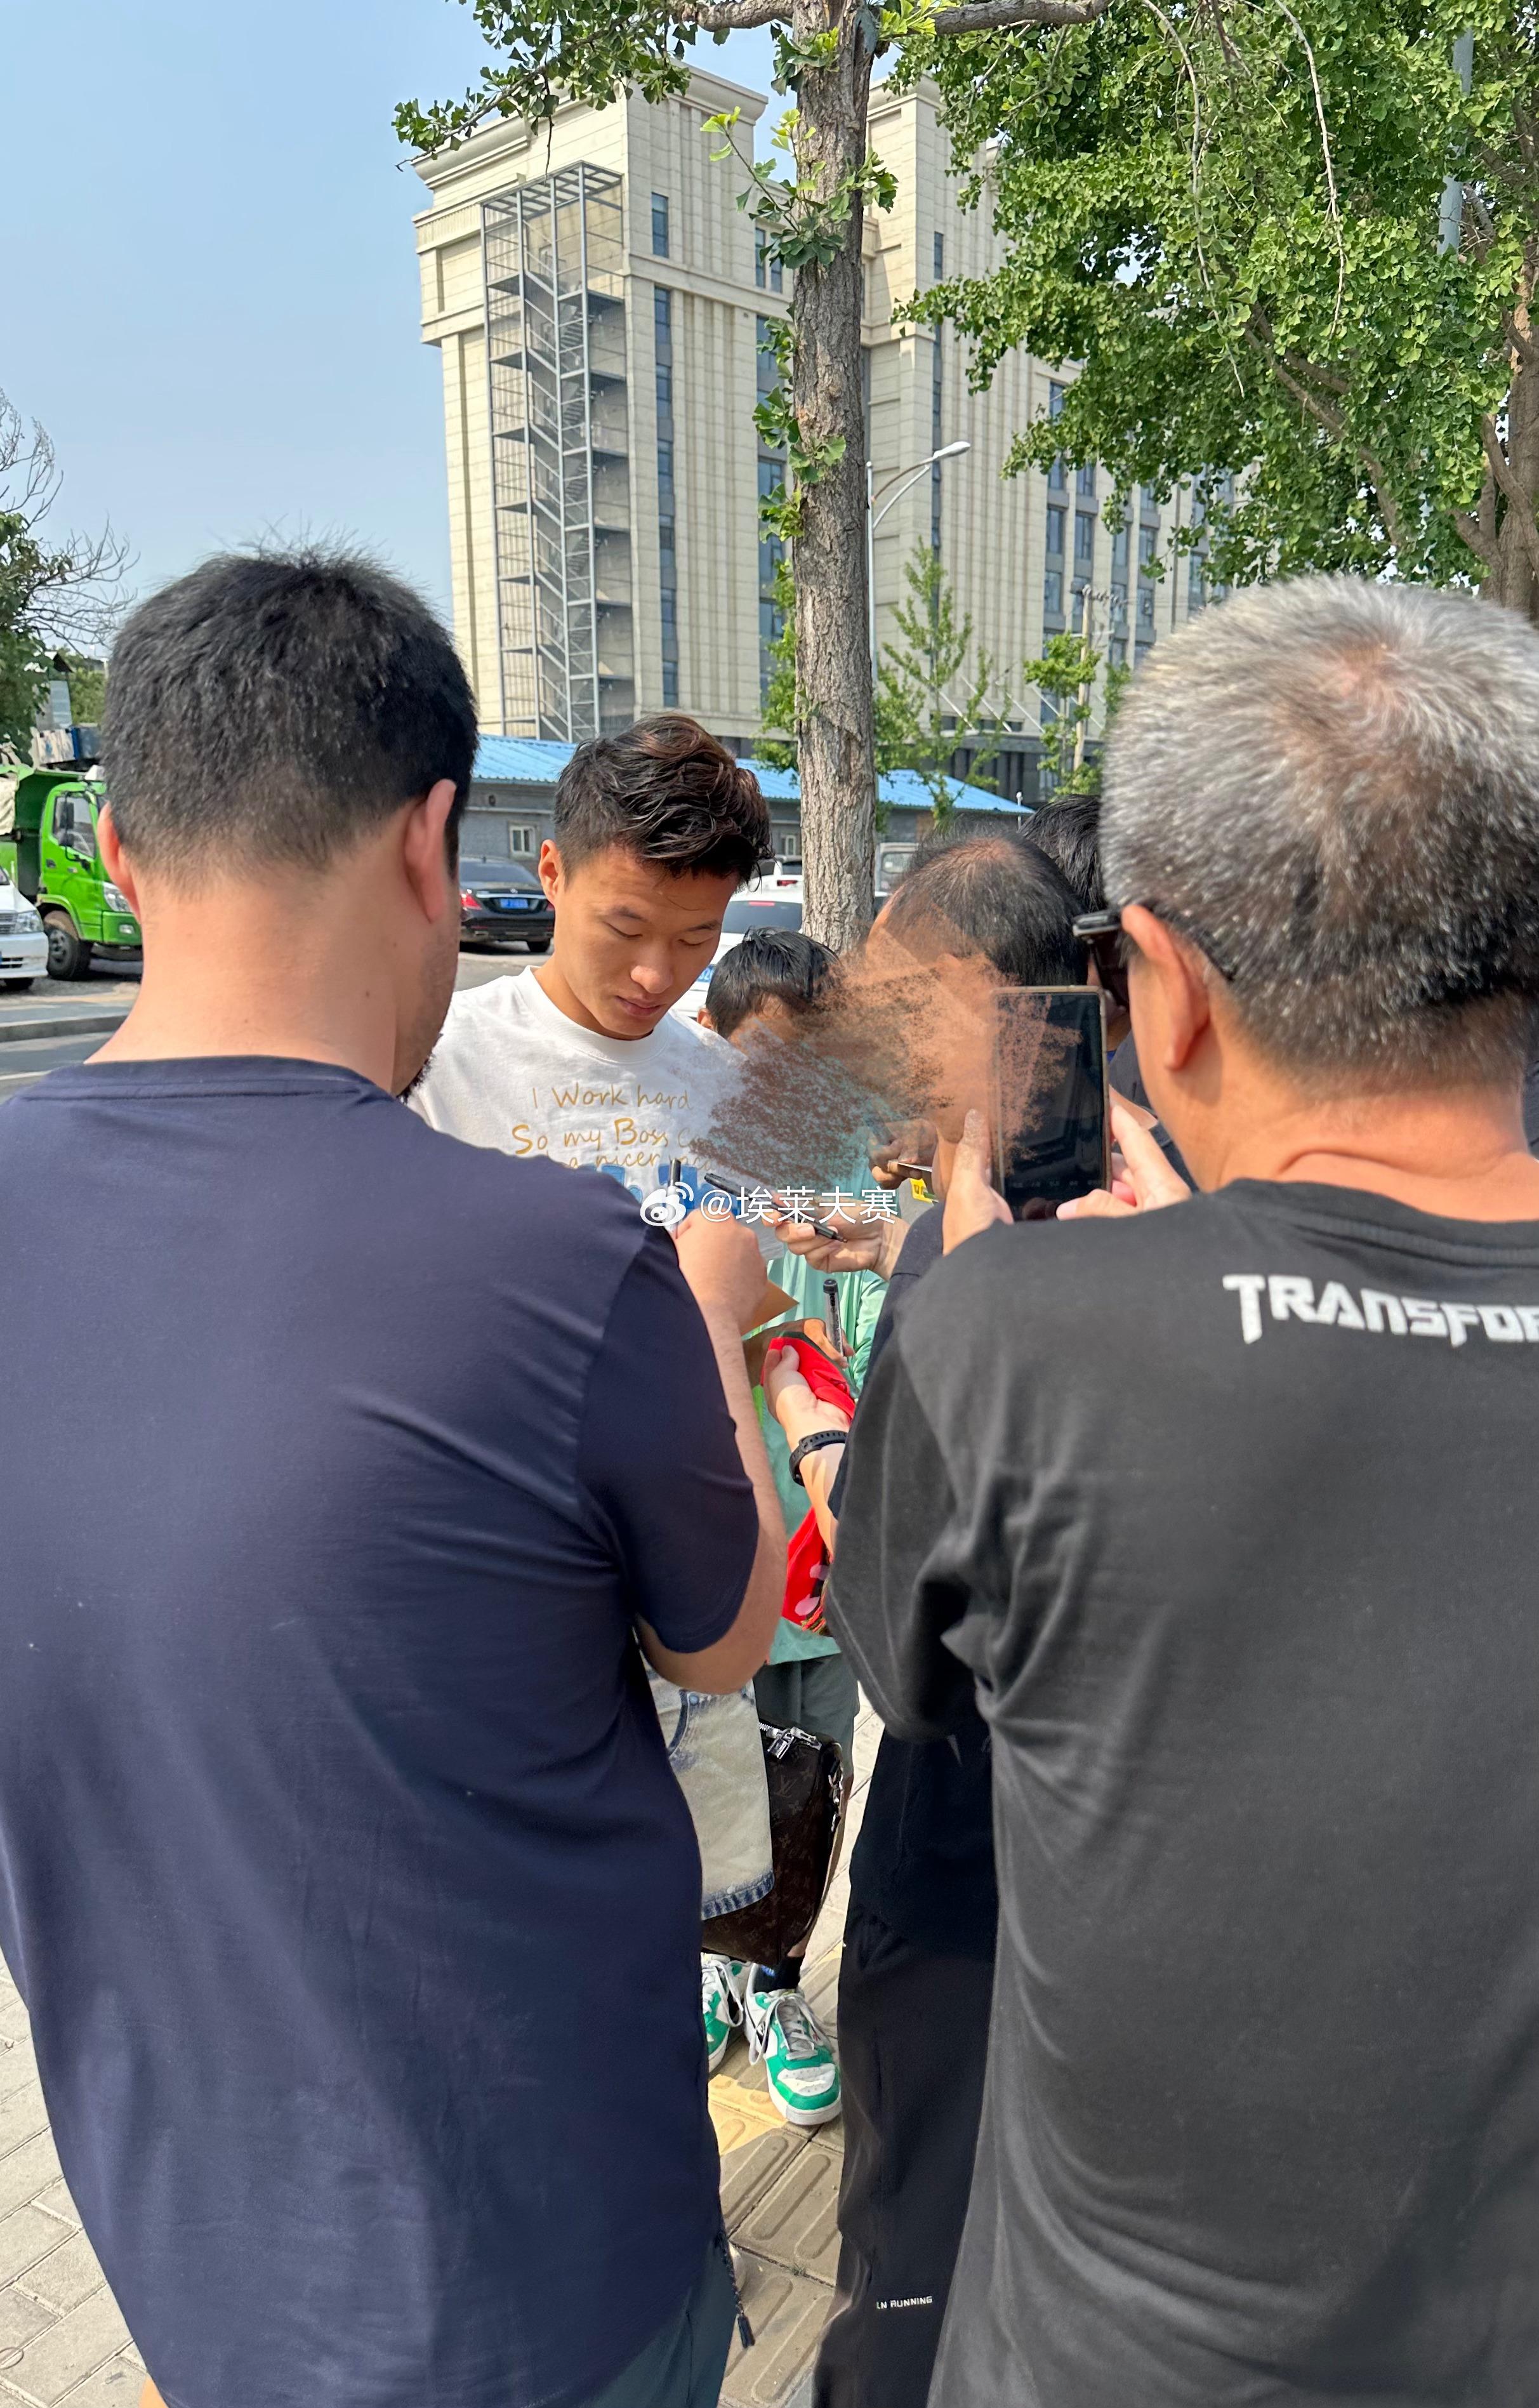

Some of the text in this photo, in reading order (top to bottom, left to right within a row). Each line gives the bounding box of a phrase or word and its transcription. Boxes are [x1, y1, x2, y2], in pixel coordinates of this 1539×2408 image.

[532, 1081, 694, 1109] I Work hard
[512, 1123, 548, 1155] So
[564, 1129, 601, 1151] my
[614, 1116, 669, 1148] Boss
[595, 1146, 661, 1168] nicer
[890, 2296, 933, 2308] RUNNING
